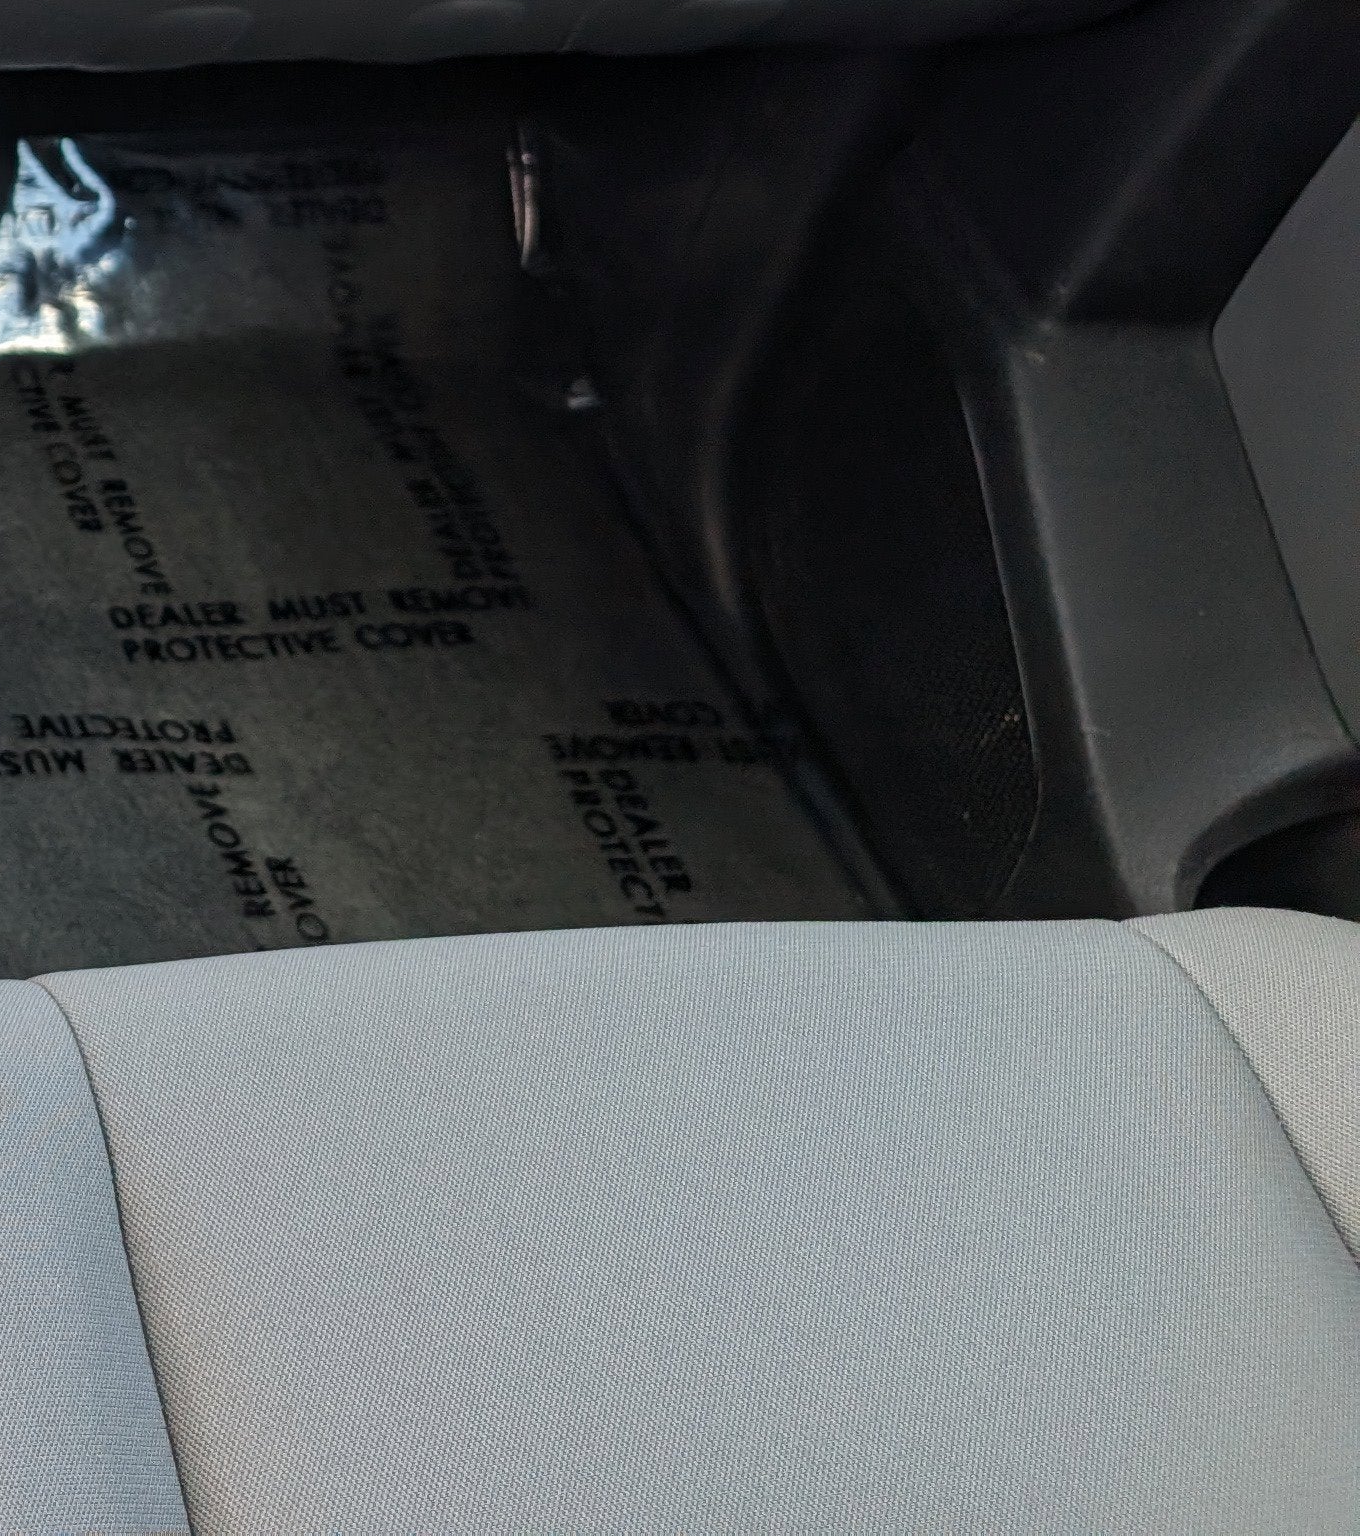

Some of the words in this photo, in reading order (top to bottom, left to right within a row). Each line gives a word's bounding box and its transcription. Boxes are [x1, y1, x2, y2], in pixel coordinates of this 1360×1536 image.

[106, 599, 246, 632] DEALER
[267, 590, 368, 623] MUST
[121, 627, 343, 664] PROTECTIVE
[354, 620, 475, 652] COVER
[10, 713, 240, 745] PROTECTIVE
[110, 747, 258, 778] DEALER
